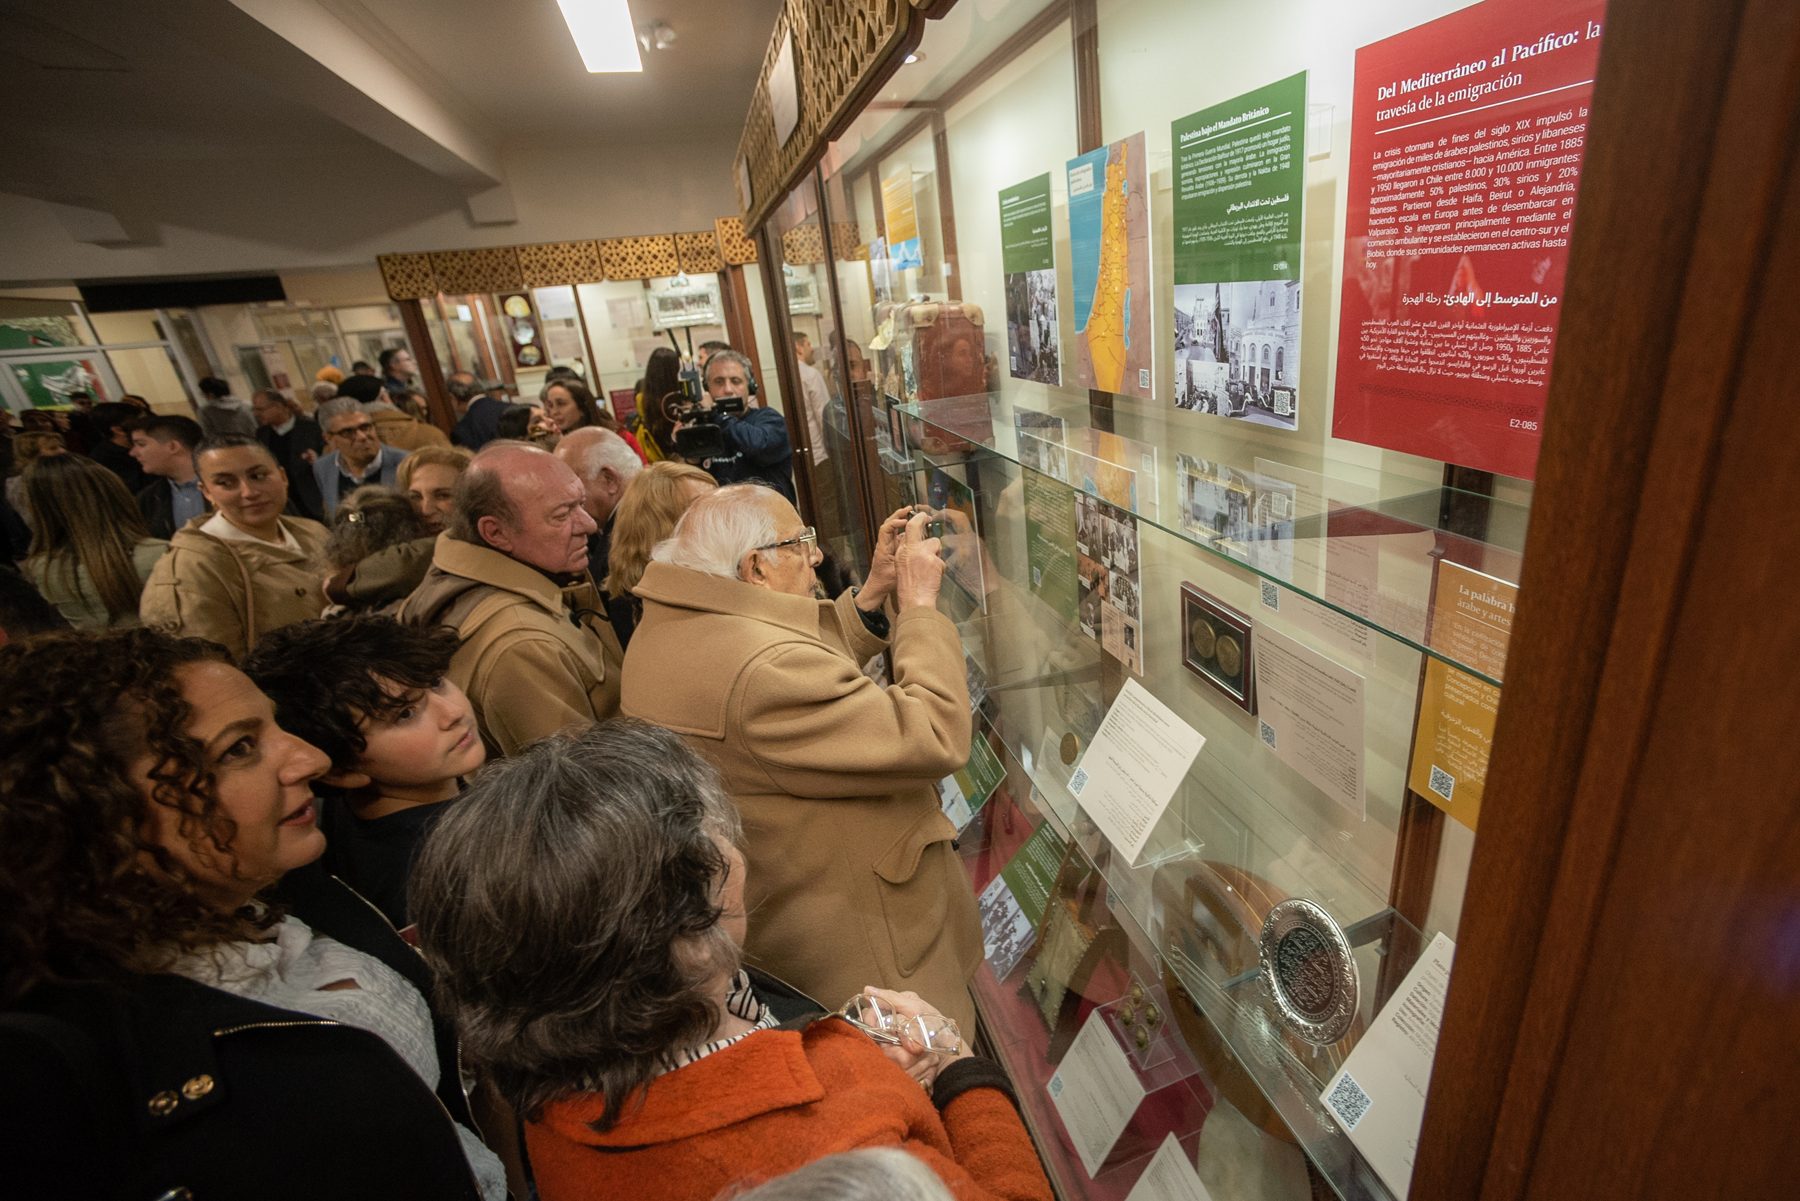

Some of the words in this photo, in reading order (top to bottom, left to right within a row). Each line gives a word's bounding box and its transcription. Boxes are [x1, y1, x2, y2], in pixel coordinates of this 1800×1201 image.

[1377, 82, 1396, 101] Del
[1400, 60, 1487, 95] Mediterráneo
[1491, 48, 1506, 68] al
[1511, 31, 1579, 62] Pacífico:
[1585, 21, 1601, 40] la
[1376, 99, 1416, 122] travesía
[1418, 95, 1433, 111] de
[1434, 91, 1445, 107] la
[1447, 72, 1522, 103] emigración
[1181, 129, 1201, 142] Palestina
[1219, 118, 1241, 128] Mandato
[1243, 108, 1269, 121] Británico
[1373, 152, 1382, 160] La
[1384, 147, 1401, 157] crisis
[1404, 141, 1434, 153] otomana
[1438, 137, 1448, 147] de
[1452, 133, 1470, 144] fines
[1474, 128, 1487, 139] del
[1490, 123, 1511, 137] siglo
[1515, 118, 1531, 131] XIX
[1536, 109, 1573, 126] impulsó
[1578, 107, 1588, 117] la
[1406, 155, 1415, 165] de
[1415, 153, 1434, 163] miles
[1434, 150, 1444, 160] de
[1443, 146, 1468, 158] árabes
[1468, 138, 1510, 155] palestinos,
[1511, 133, 1534, 145] sirios
[1535, 132, 1541, 143] y
[1541, 123, 1586, 139] libaneses
[1473, 153, 1495, 165] hacia
[1533, 143, 1558, 155] Entre
[1560, 136, 1584, 150] 1885
[1371, 187, 1375, 195] y
[1377, 182, 1392, 192] 1950
[1393, 179, 1418, 191] llegaron
[1419, 178, 1425, 186] a
[1426, 174, 1443, 185] Chile
[1444, 172, 1464, 182] entre
[1464, 167, 1487, 179] 8.000
[1488, 168, 1494, 178] y
[1496, 161, 1524, 174] 10.000
[1429, 186, 1444, 196] 50%
[1448, 181, 1488, 195] palestinos,
[1493, 176, 1511, 188] 30%
[1516, 173, 1540, 184] sirios
[1545, 172, 1552, 183] y
[1558, 166, 1578, 179] 20%
[1368, 215, 1396, 226] haciendo
[1398, 213, 1419, 223] escala
[1434, 209, 1459, 219] Europa
[1462, 207, 1484, 216] antes
[1487, 204, 1498, 214] de
[1501, 198, 1557, 212] desembarcar
[1561, 197, 1574, 206] en
[1402, 201, 1432, 211] Partieron
[1436, 196, 1458, 207] desde
[1462, 193, 1484, 204] Haifa,
[1489, 190, 1513, 201] Beirut
[1518, 189, 1525, 197] o
[1404, 225, 1413, 234] Se
[1417, 222, 1451, 233] integraron
[1455, 216, 1511, 231] principalmente
[1516, 212, 1557, 223] mediante
[1562, 209, 1572, 219] el
[1394, 236, 1428, 245] ambulante
[1428, 236, 1433, 245] y
[1433, 235, 1442, 243] se
[1442, 231, 1490, 242] establecieron
[1490, 230, 1501, 238] en
[1501, 228, 1510, 238] el
[1510, 226, 1553, 237] centro-sur
[1553, 226, 1560, 236] y
[1560, 223, 1570, 233] el
[1386, 248, 1405, 257] donde
[1405, 248, 1417, 258] sus
[1418, 244, 1463, 255] comunidades
[1463, 242, 1511, 254] permanecen
[1511, 240, 1541, 250] activas
[1542, 238, 1567, 248] hasta
[1403, 293, 1423, 305] الهجرة
[1426, 294, 1440, 305] رحلة
[1476, 292, 1491, 307] إلى
[1494, 292, 1538, 306] المتوسط
[1540, 295, 1557, 306] من
[1516, 344, 1532, 353] 1885
[1510, 419, 1537, 431] E2-085
[1459, 585, 1469, 595] La
[1471, 592, 1506, 610] palabra
[1489, 612, 1512, 625] artes
